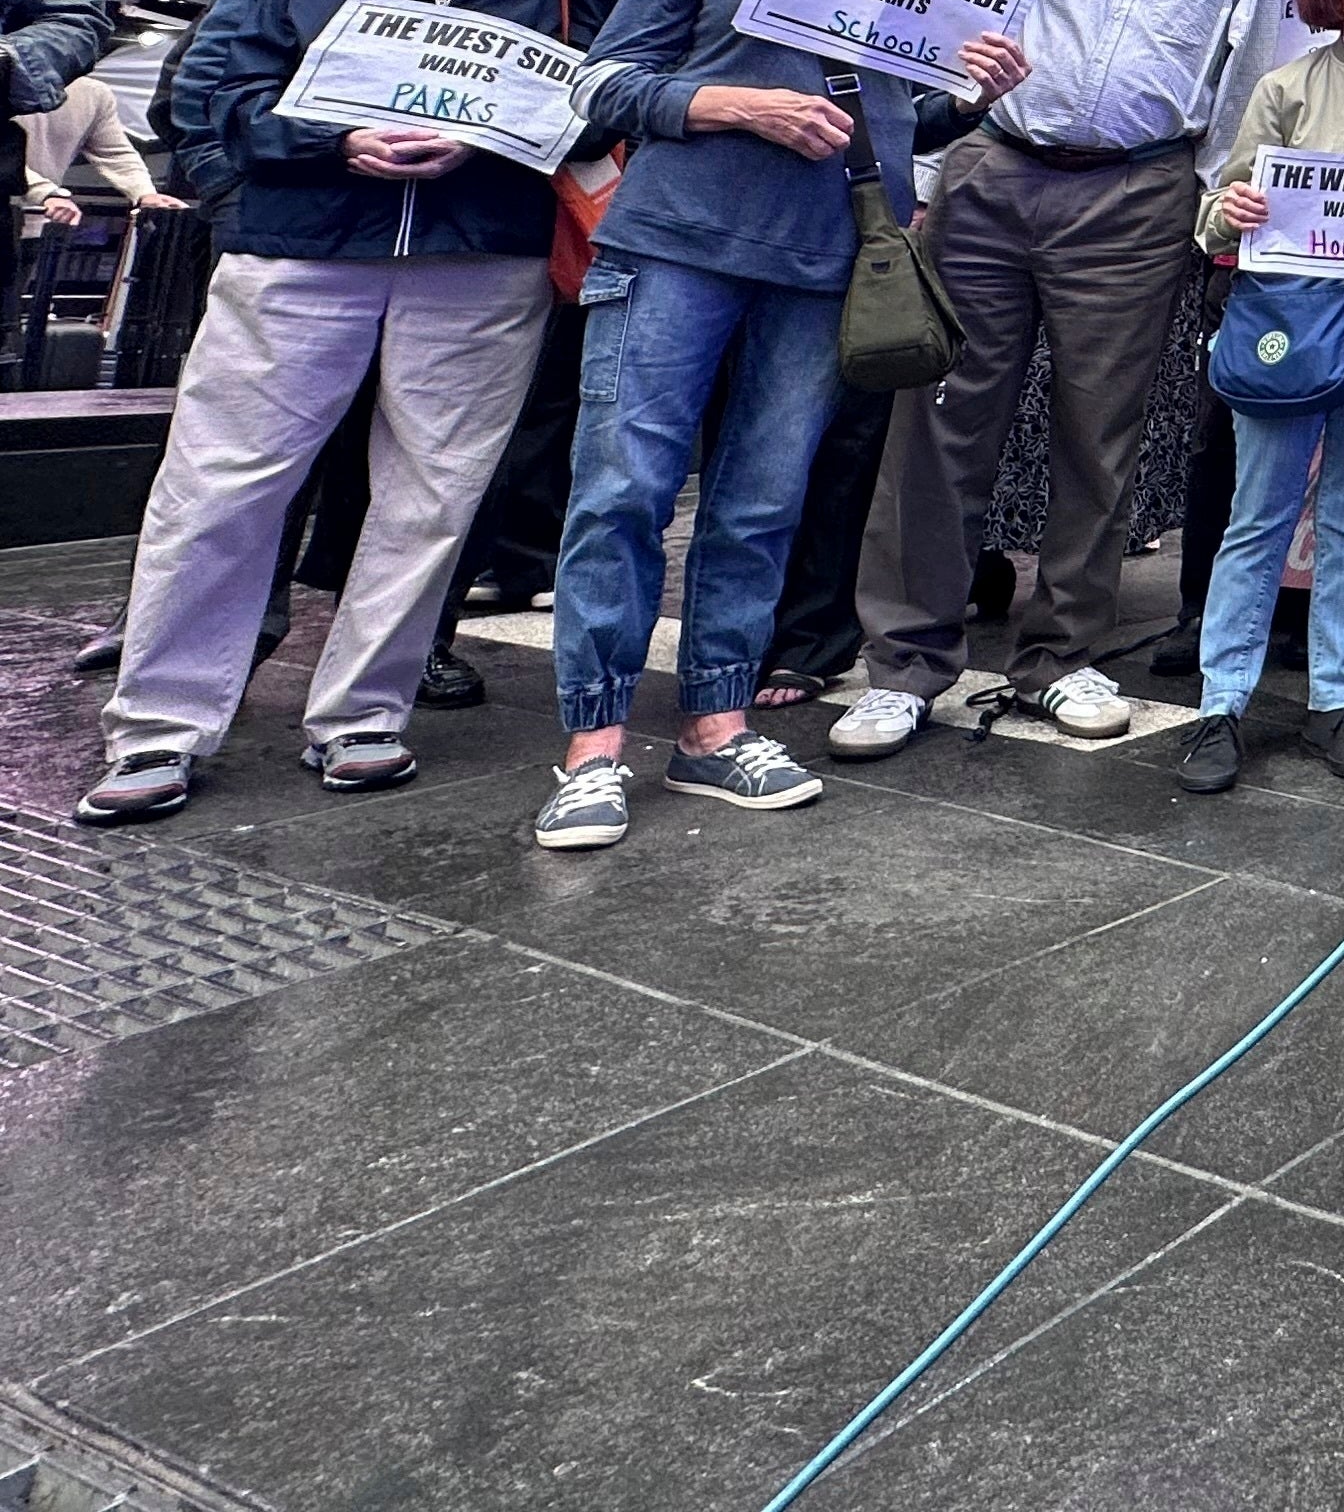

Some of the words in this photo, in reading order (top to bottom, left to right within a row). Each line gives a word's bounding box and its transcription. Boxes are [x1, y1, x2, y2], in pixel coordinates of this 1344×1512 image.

[356, 11, 425, 41] THE
[422, 21, 519, 60] WEST
[827, 9, 942, 64] Schools
[418, 53, 499, 84] WANTS
[390, 82, 499, 124] PARKS
[1271, 163, 1316, 190] THE
